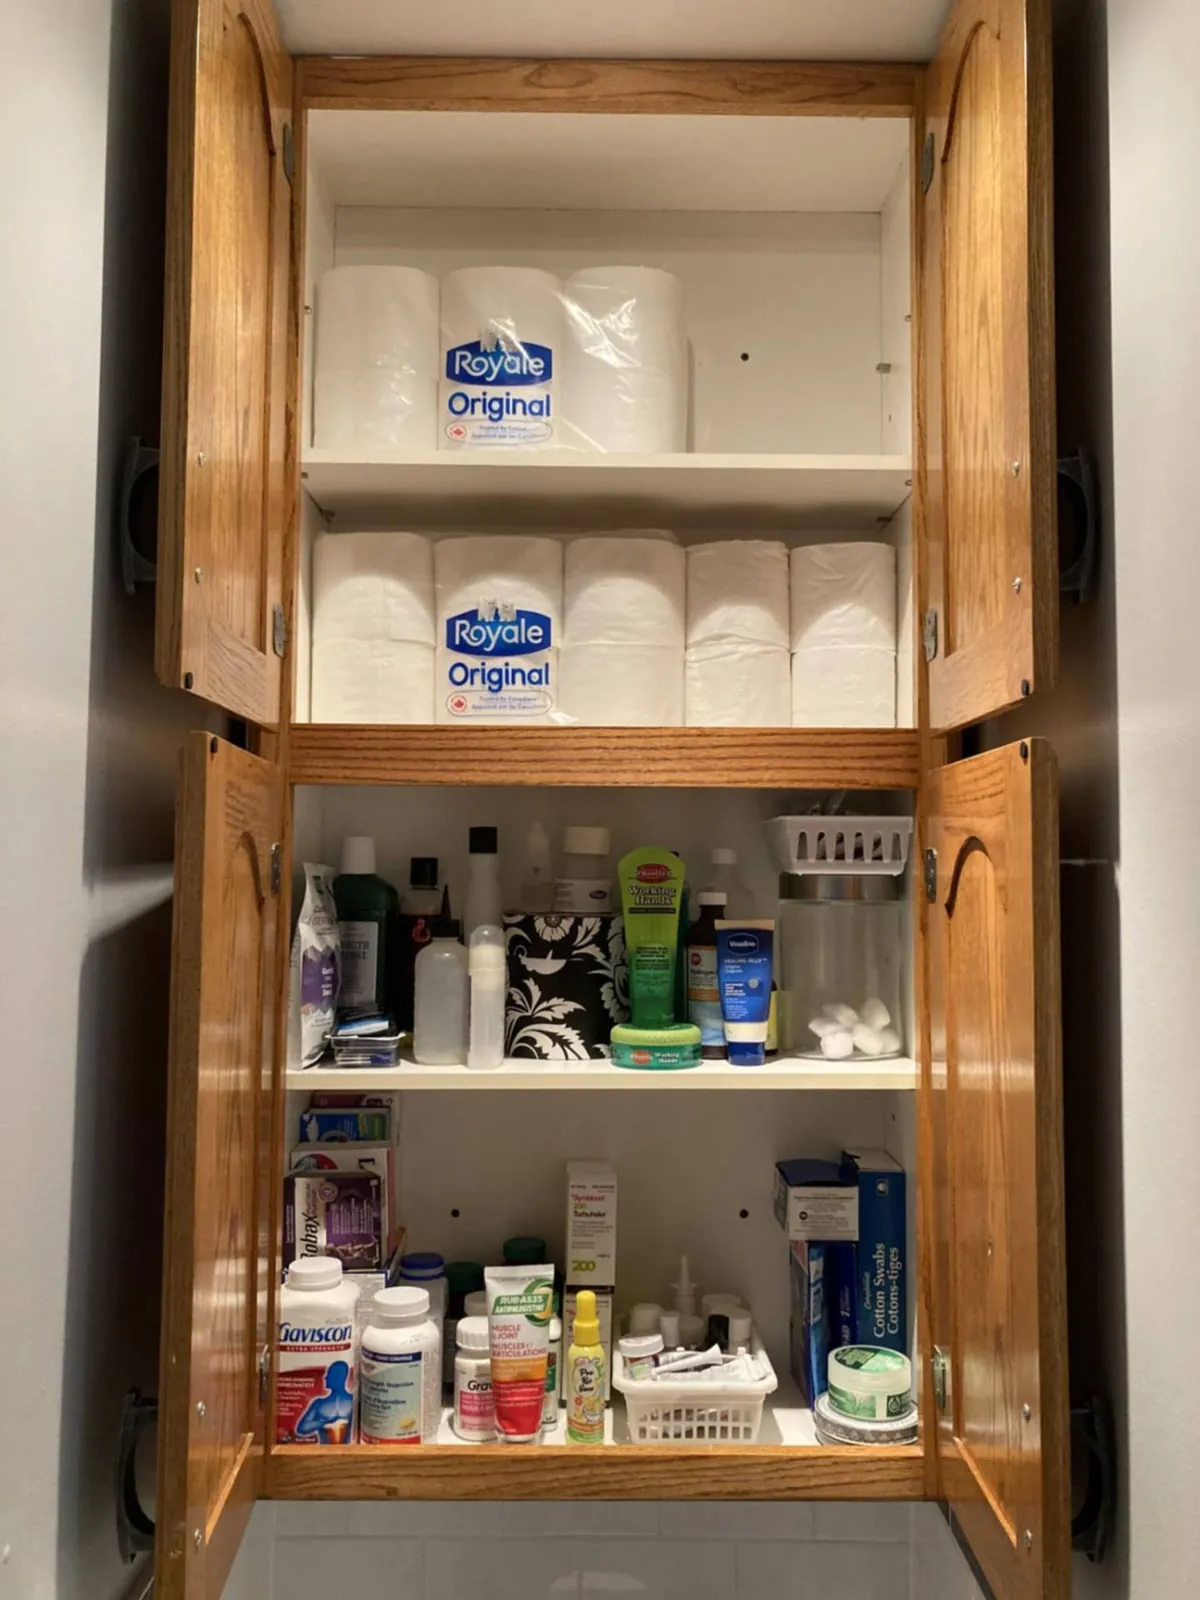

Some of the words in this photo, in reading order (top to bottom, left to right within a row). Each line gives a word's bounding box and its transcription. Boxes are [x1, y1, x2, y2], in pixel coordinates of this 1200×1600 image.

[455, 350, 545, 382] Royale
[448, 391, 551, 423] Original
[455, 618, 543, 652] Royale
[448, 662, 549, 693] Original
[628, 885, 676, 897] Working
[635, 896, 673, 905] Hands
[572, 1260, 596, 1272] 200
[872, 1242, 886, 1286] Swabs
[887, 1247, 901, 1335] Cotons-tiges
[873, 1293, 886, 1338] Cotton
[279, 1322, 352, 1343] Gaviscon
[492, 1324, 521, 1332] MUSCLE
[499, 1332, 518, 1340] JOINT
[492, 1342, 525, 1350] MUSCLES
[492, 1349, 546, 1358] ARTICULATIONS
